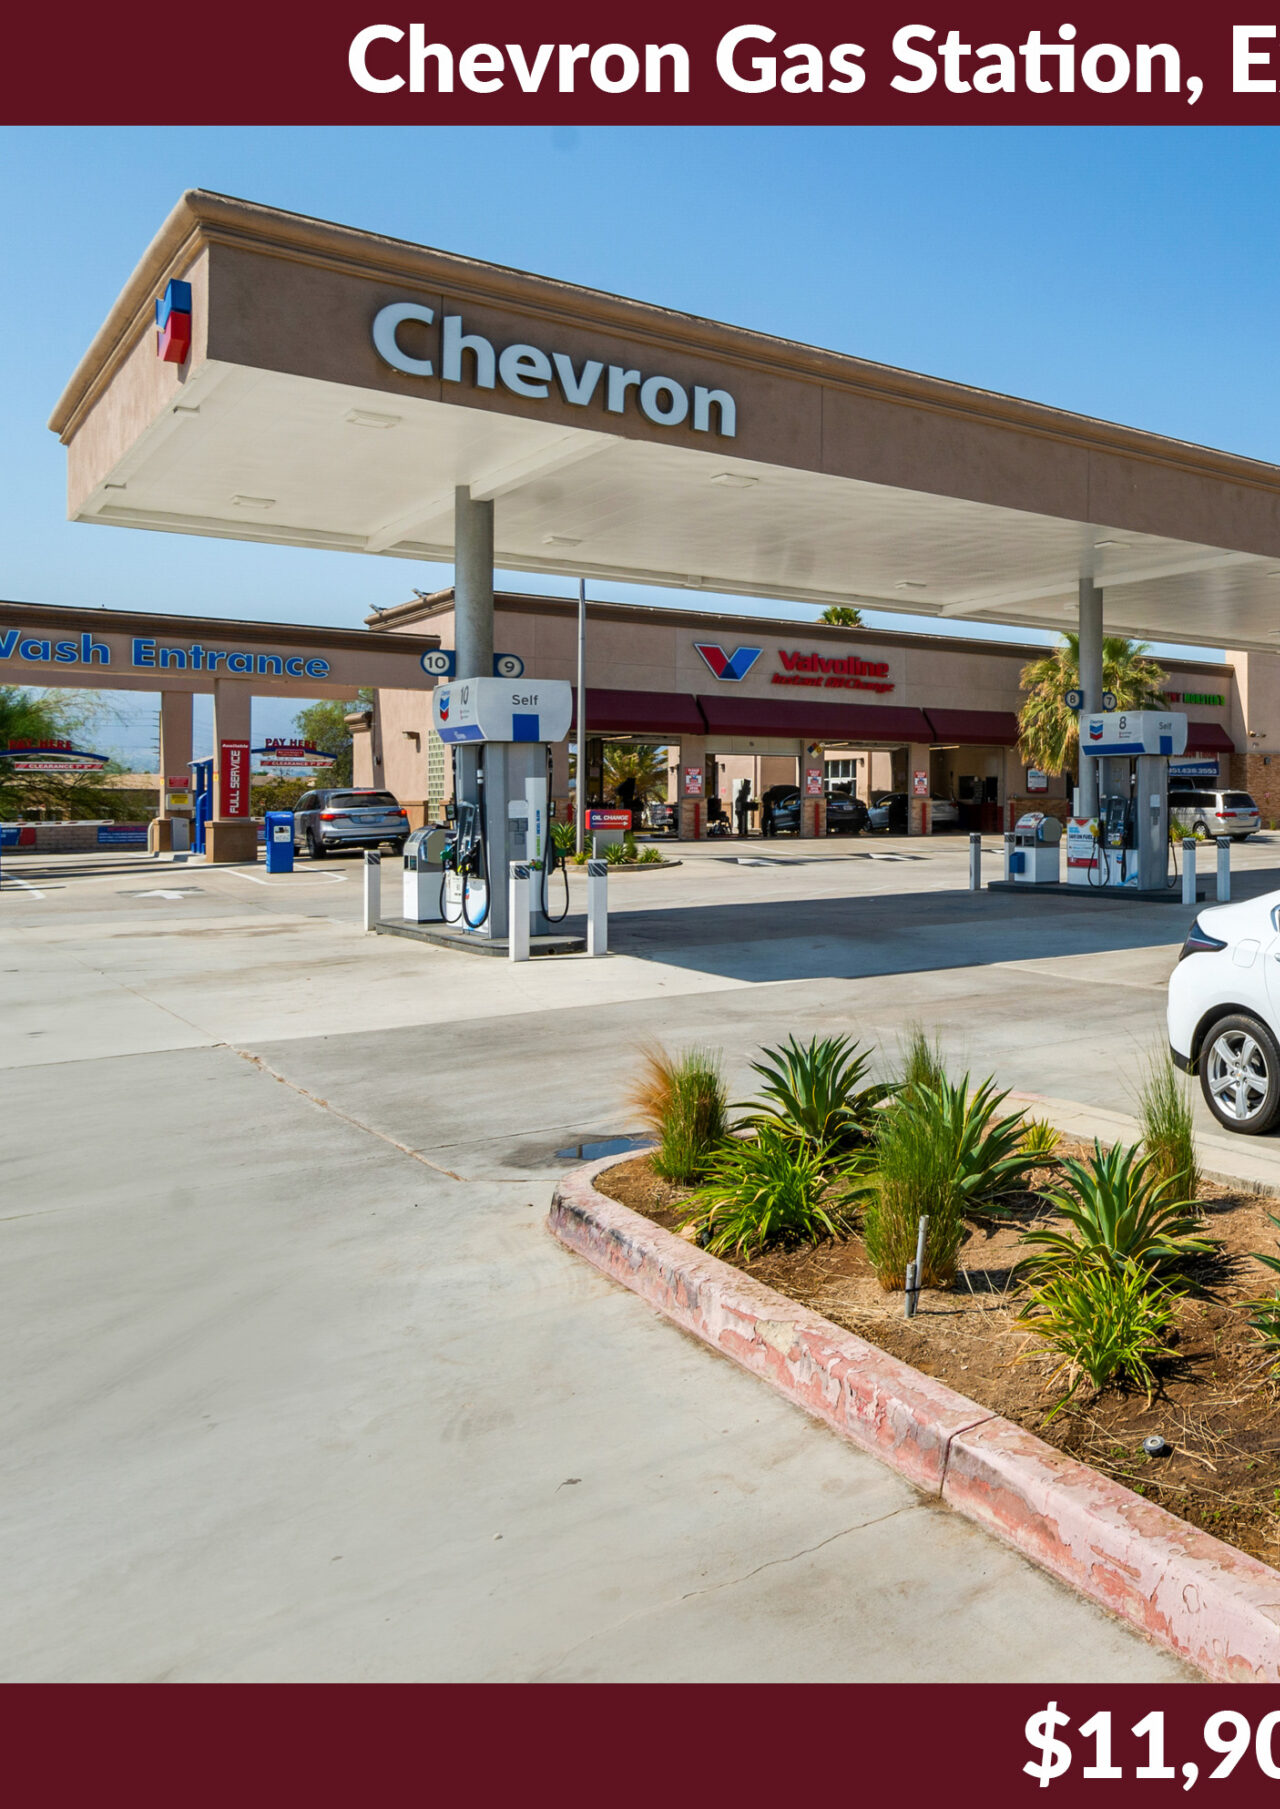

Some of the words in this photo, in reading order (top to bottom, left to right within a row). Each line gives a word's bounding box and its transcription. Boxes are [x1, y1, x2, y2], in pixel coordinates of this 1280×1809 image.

[371, 301, 736, 438] Chevron
[131, 637, 330, 678] Entrance
[426, 656, 447, 669] 10
[778, 650, 890, 678] Valvoline
[504, 660, 515, 673] 9
[460, 685, 469, 705] 10
[512, 694, 539, 706] Self
[1069, 694, 1076, 704] 8
[1106, 696, 1112, 706] 7
[1119, 715, 1127, 730] 8
[1158, 721, 1173, 730] Self
[265, 738, 287, 749] PAY
[290, 739, 318, 751] HERE
[230, 750, 241, 789] SERVICE
[229, 789, 240, 814] FULL
